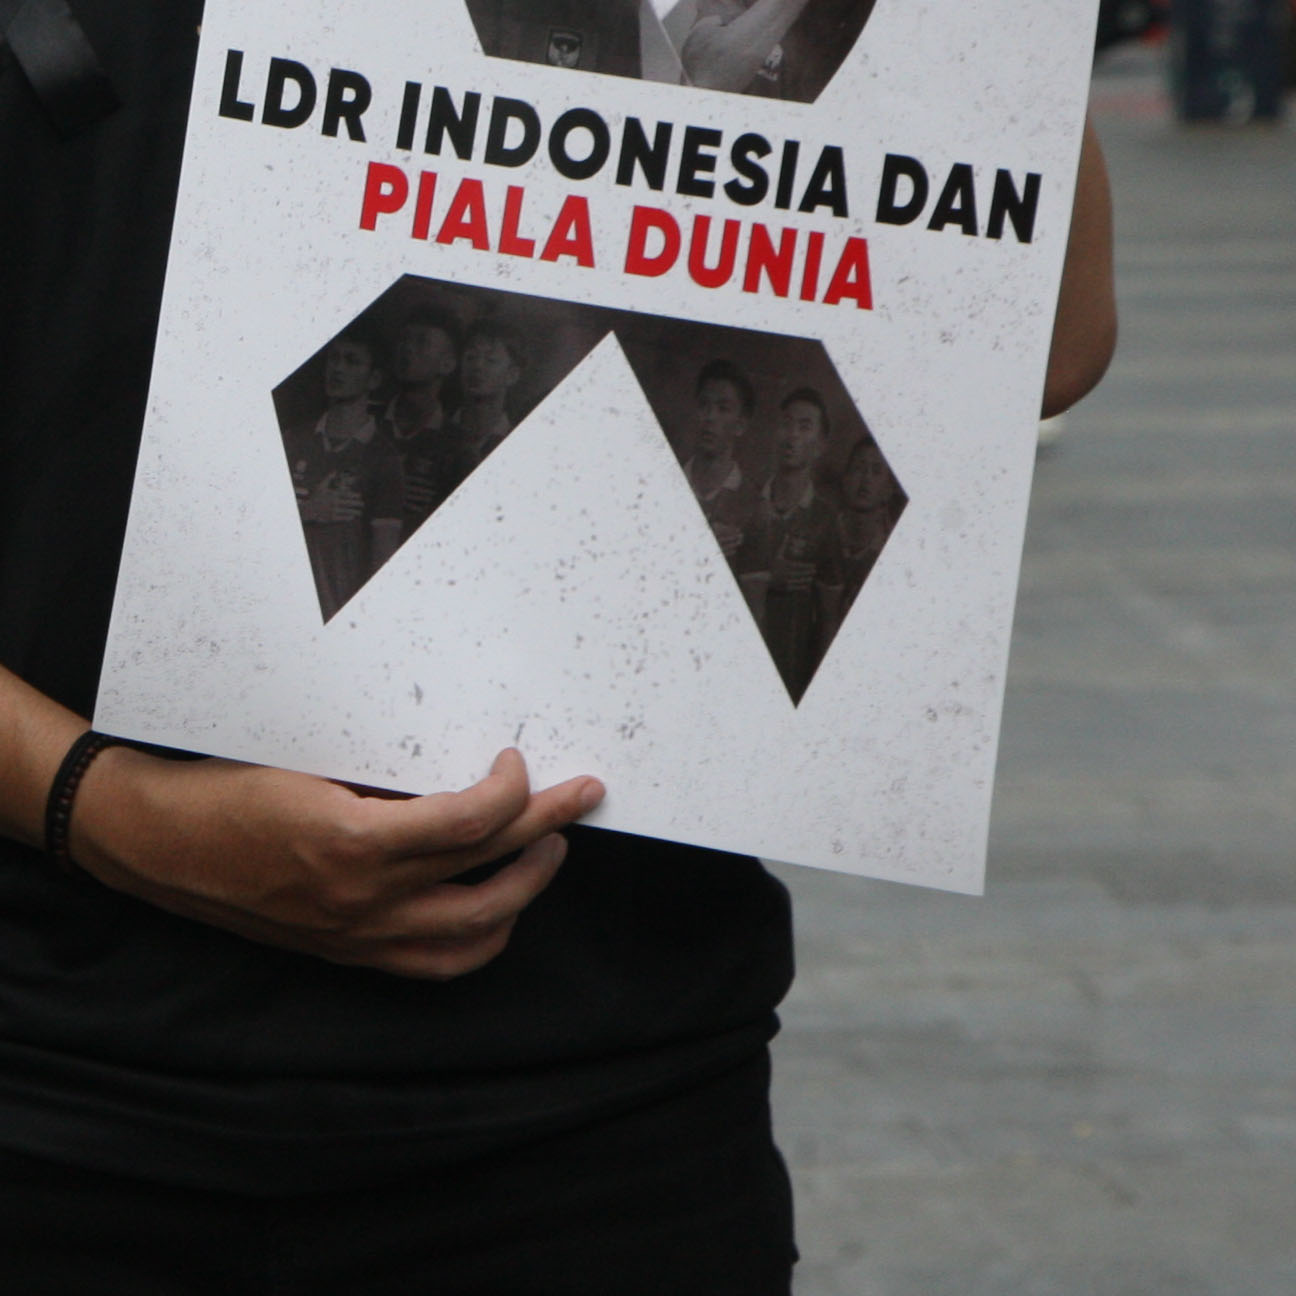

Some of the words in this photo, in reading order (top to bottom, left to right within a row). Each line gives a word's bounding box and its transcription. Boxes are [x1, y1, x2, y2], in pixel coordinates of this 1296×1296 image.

[218, 49, 372, 143] LDR
[395, 81, 849, 219] INDONESIA
[875, 153, 1042, 245] DAN
[359, 161, 595, 268] PIALA
[625, 205, 873, 310] DUNIA
